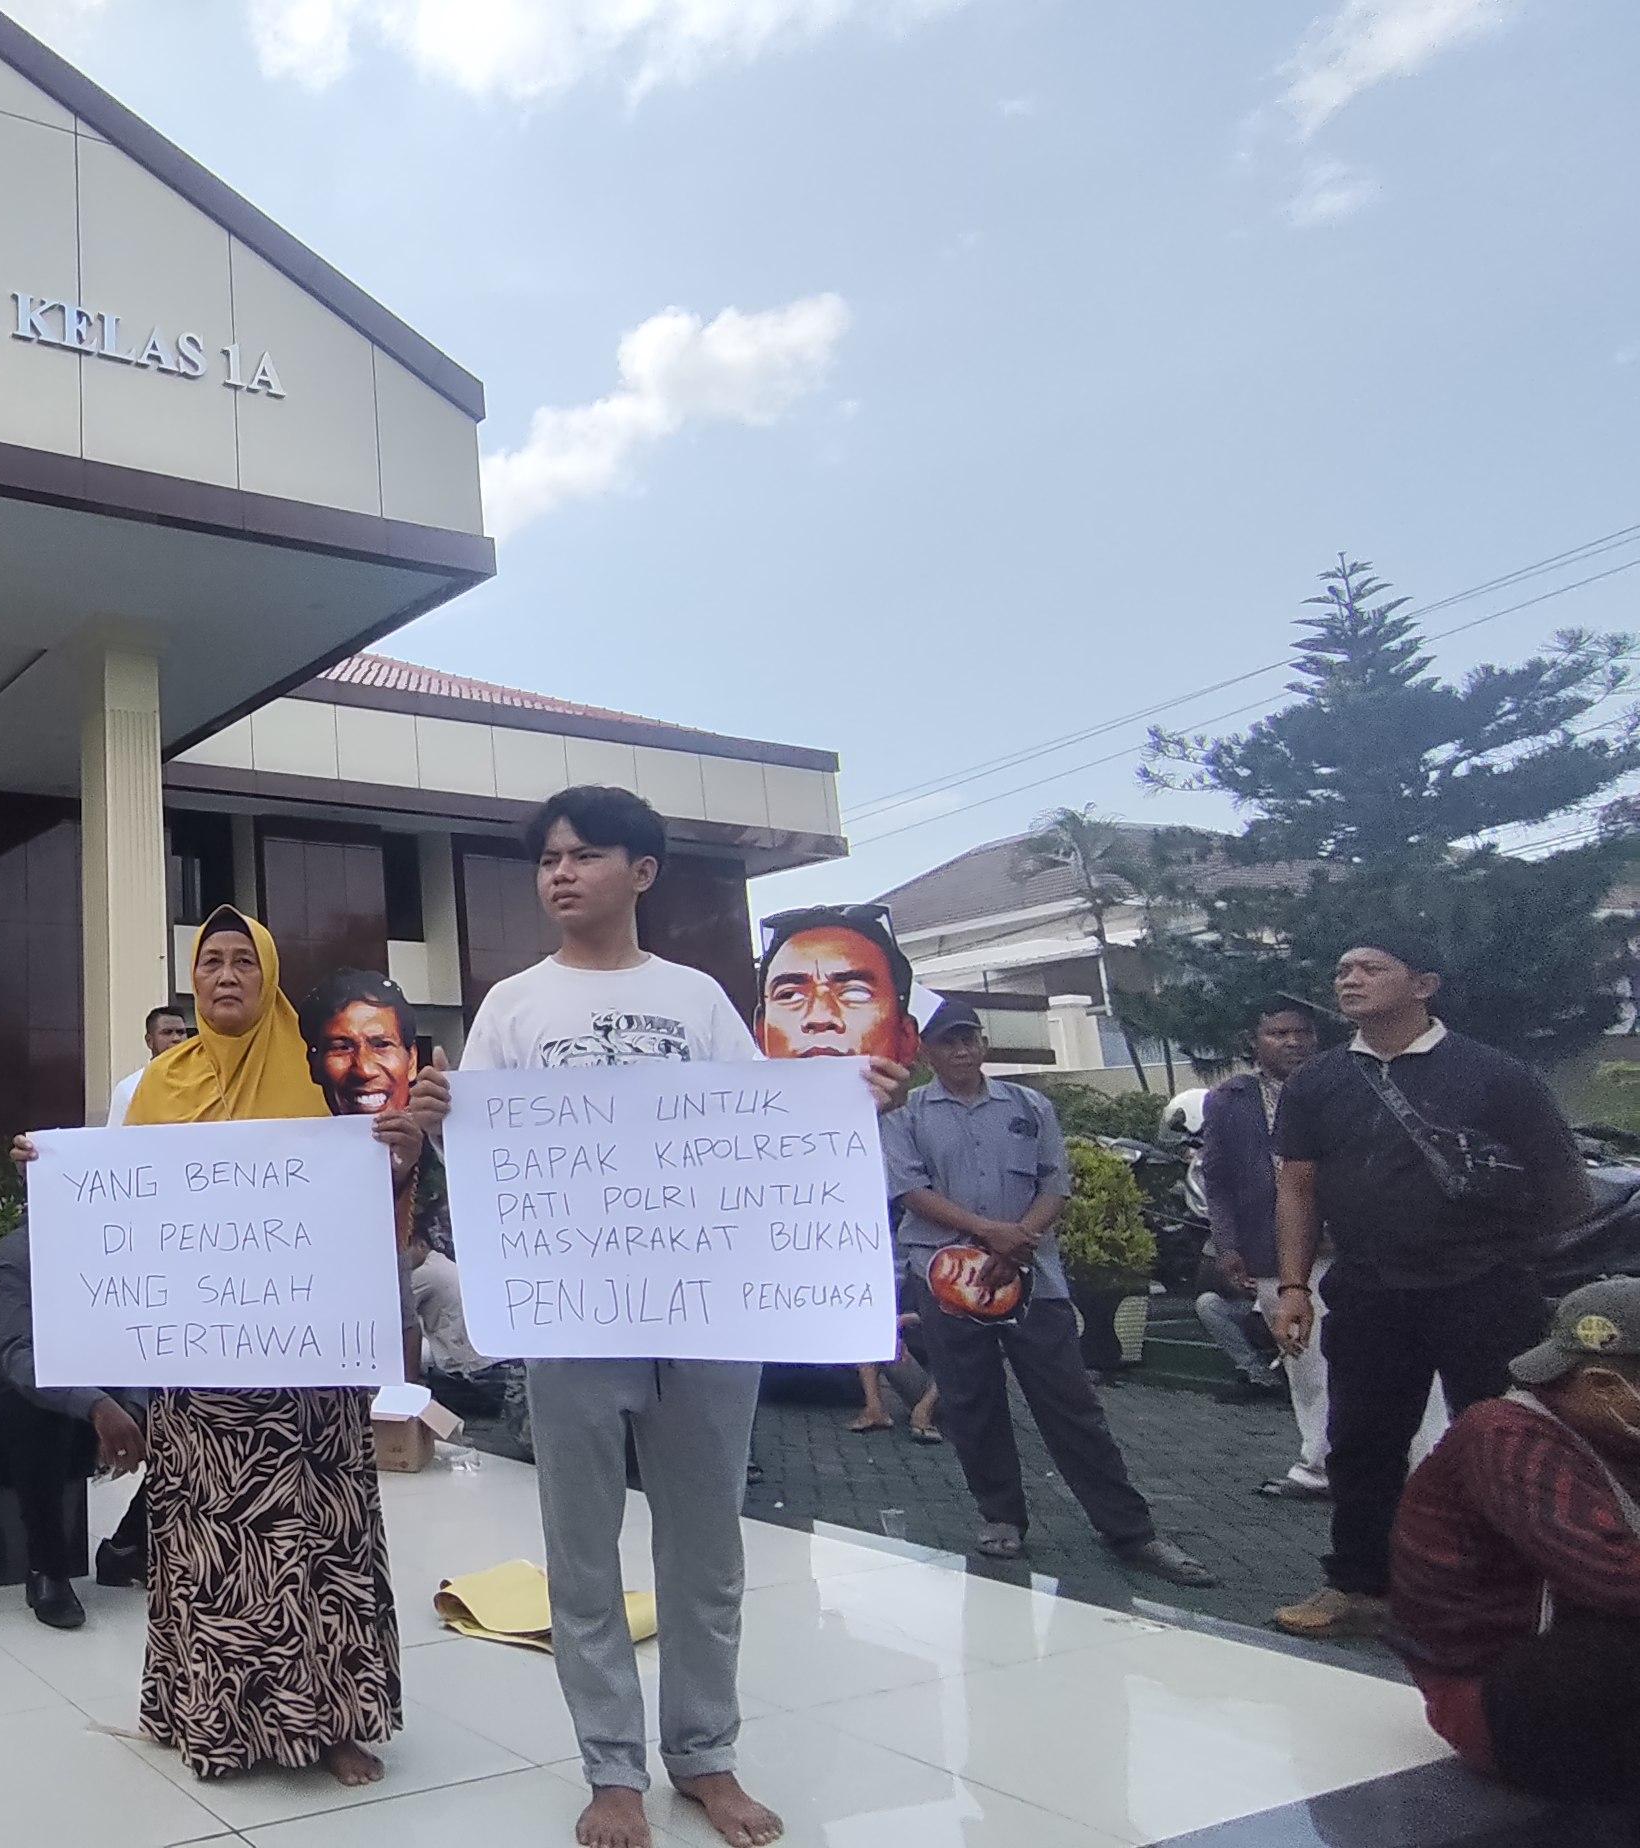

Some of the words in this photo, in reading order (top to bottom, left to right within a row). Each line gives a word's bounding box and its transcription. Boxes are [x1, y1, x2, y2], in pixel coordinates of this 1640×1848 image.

[10, 292, 208, 380] KELAS
[221, 341, 287, 398] 1A
[486, 1095, 615, 1129] PESAN
[656, 1088, 790, 1122] UNTUK
[492, 1143, 619, 1182] BAPAK
[654, 1130, 868, 1169] KAPOLRESTA
[62, 1165, 158, 1204] YANG
[185, 1158, 311, 1193] BENAR
[496, 1190, 571, 1225] PATI
[604, 1185, 696, 1215] POLRI
[720, 1181, 846, 1211] UNTUK
[160, 1219, 312, 1253] PENJARA
[501, 1224, 740, 1259] MASYARAKAT
[769, 1221, 880, 1253] BUKAN
[80, 1273, 168, 1309] YANG
[196, 1273, 314, 1307] SALAH
[743, 1281, 874, 1311] PENGUASA
